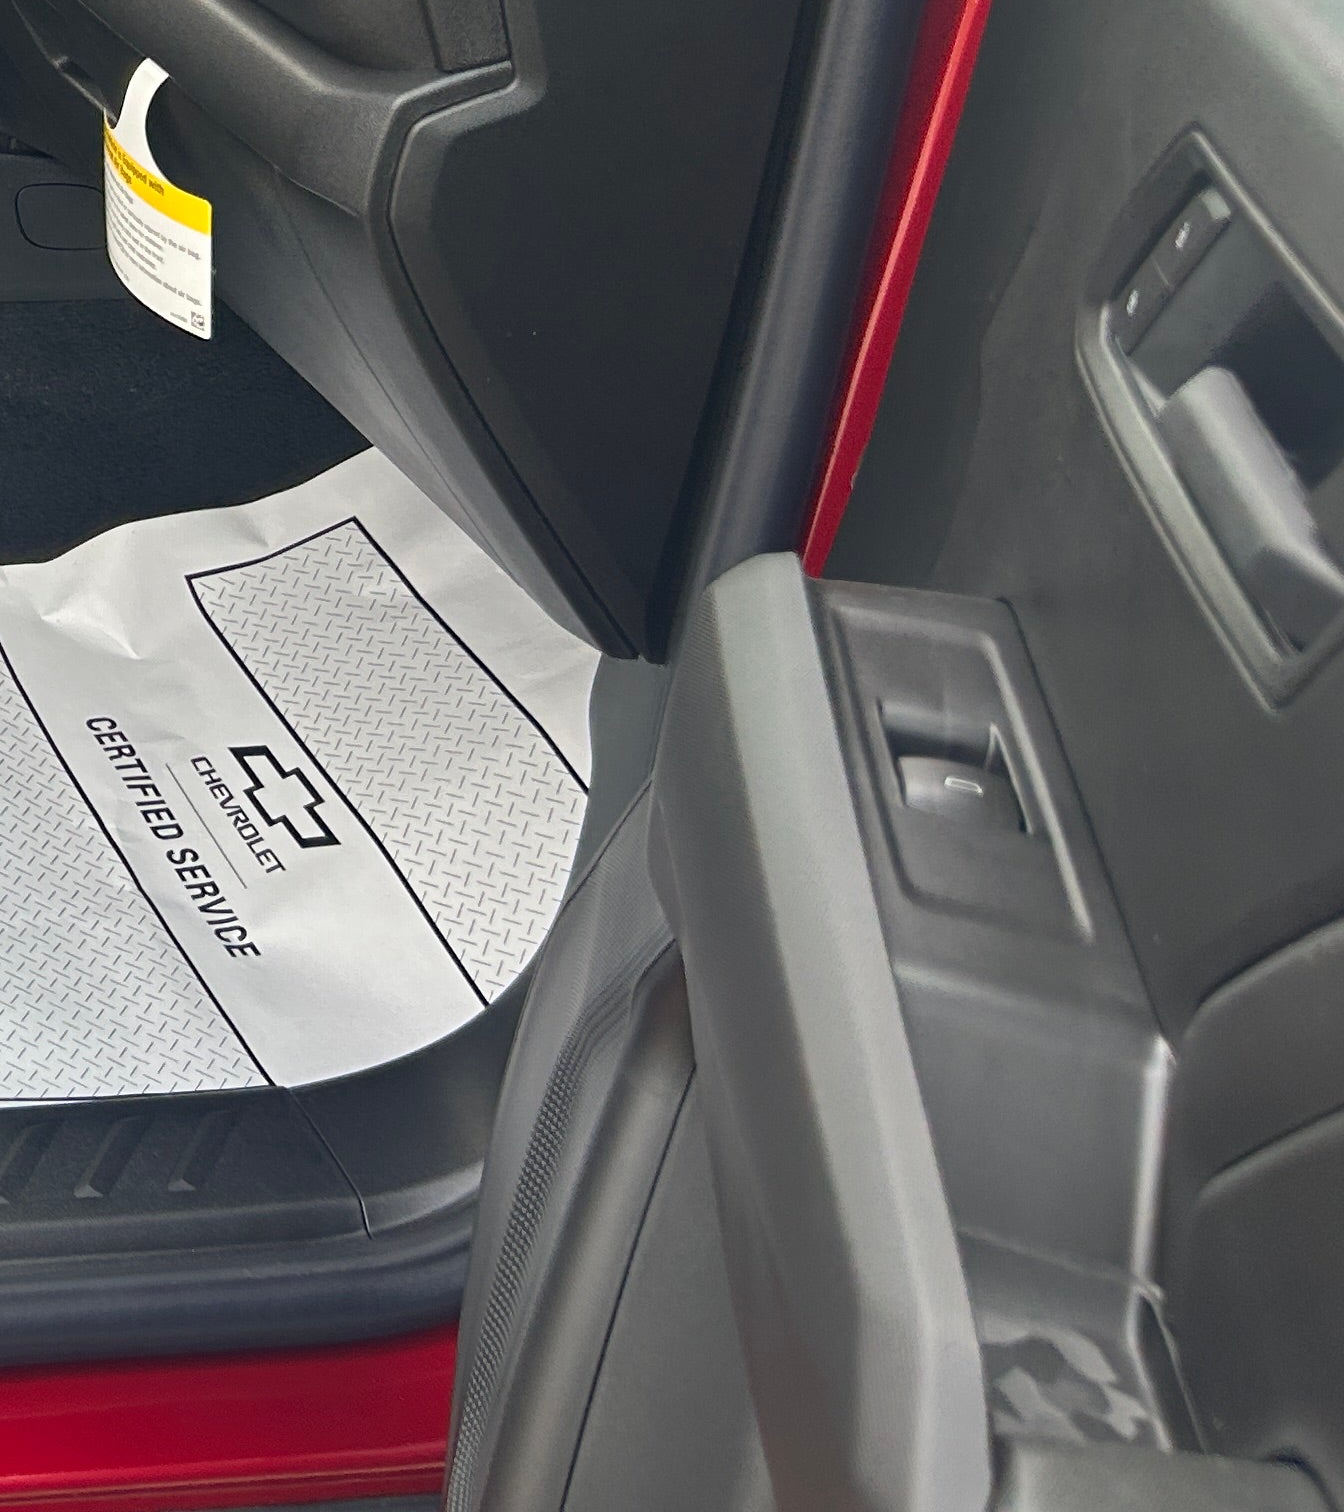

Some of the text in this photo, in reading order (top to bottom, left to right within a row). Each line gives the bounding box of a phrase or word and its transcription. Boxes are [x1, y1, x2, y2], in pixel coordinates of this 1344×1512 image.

[86, 716, 262, 959] CERTIFIED SERVICE
[190, 756, 287, 874] CHEVROLET
